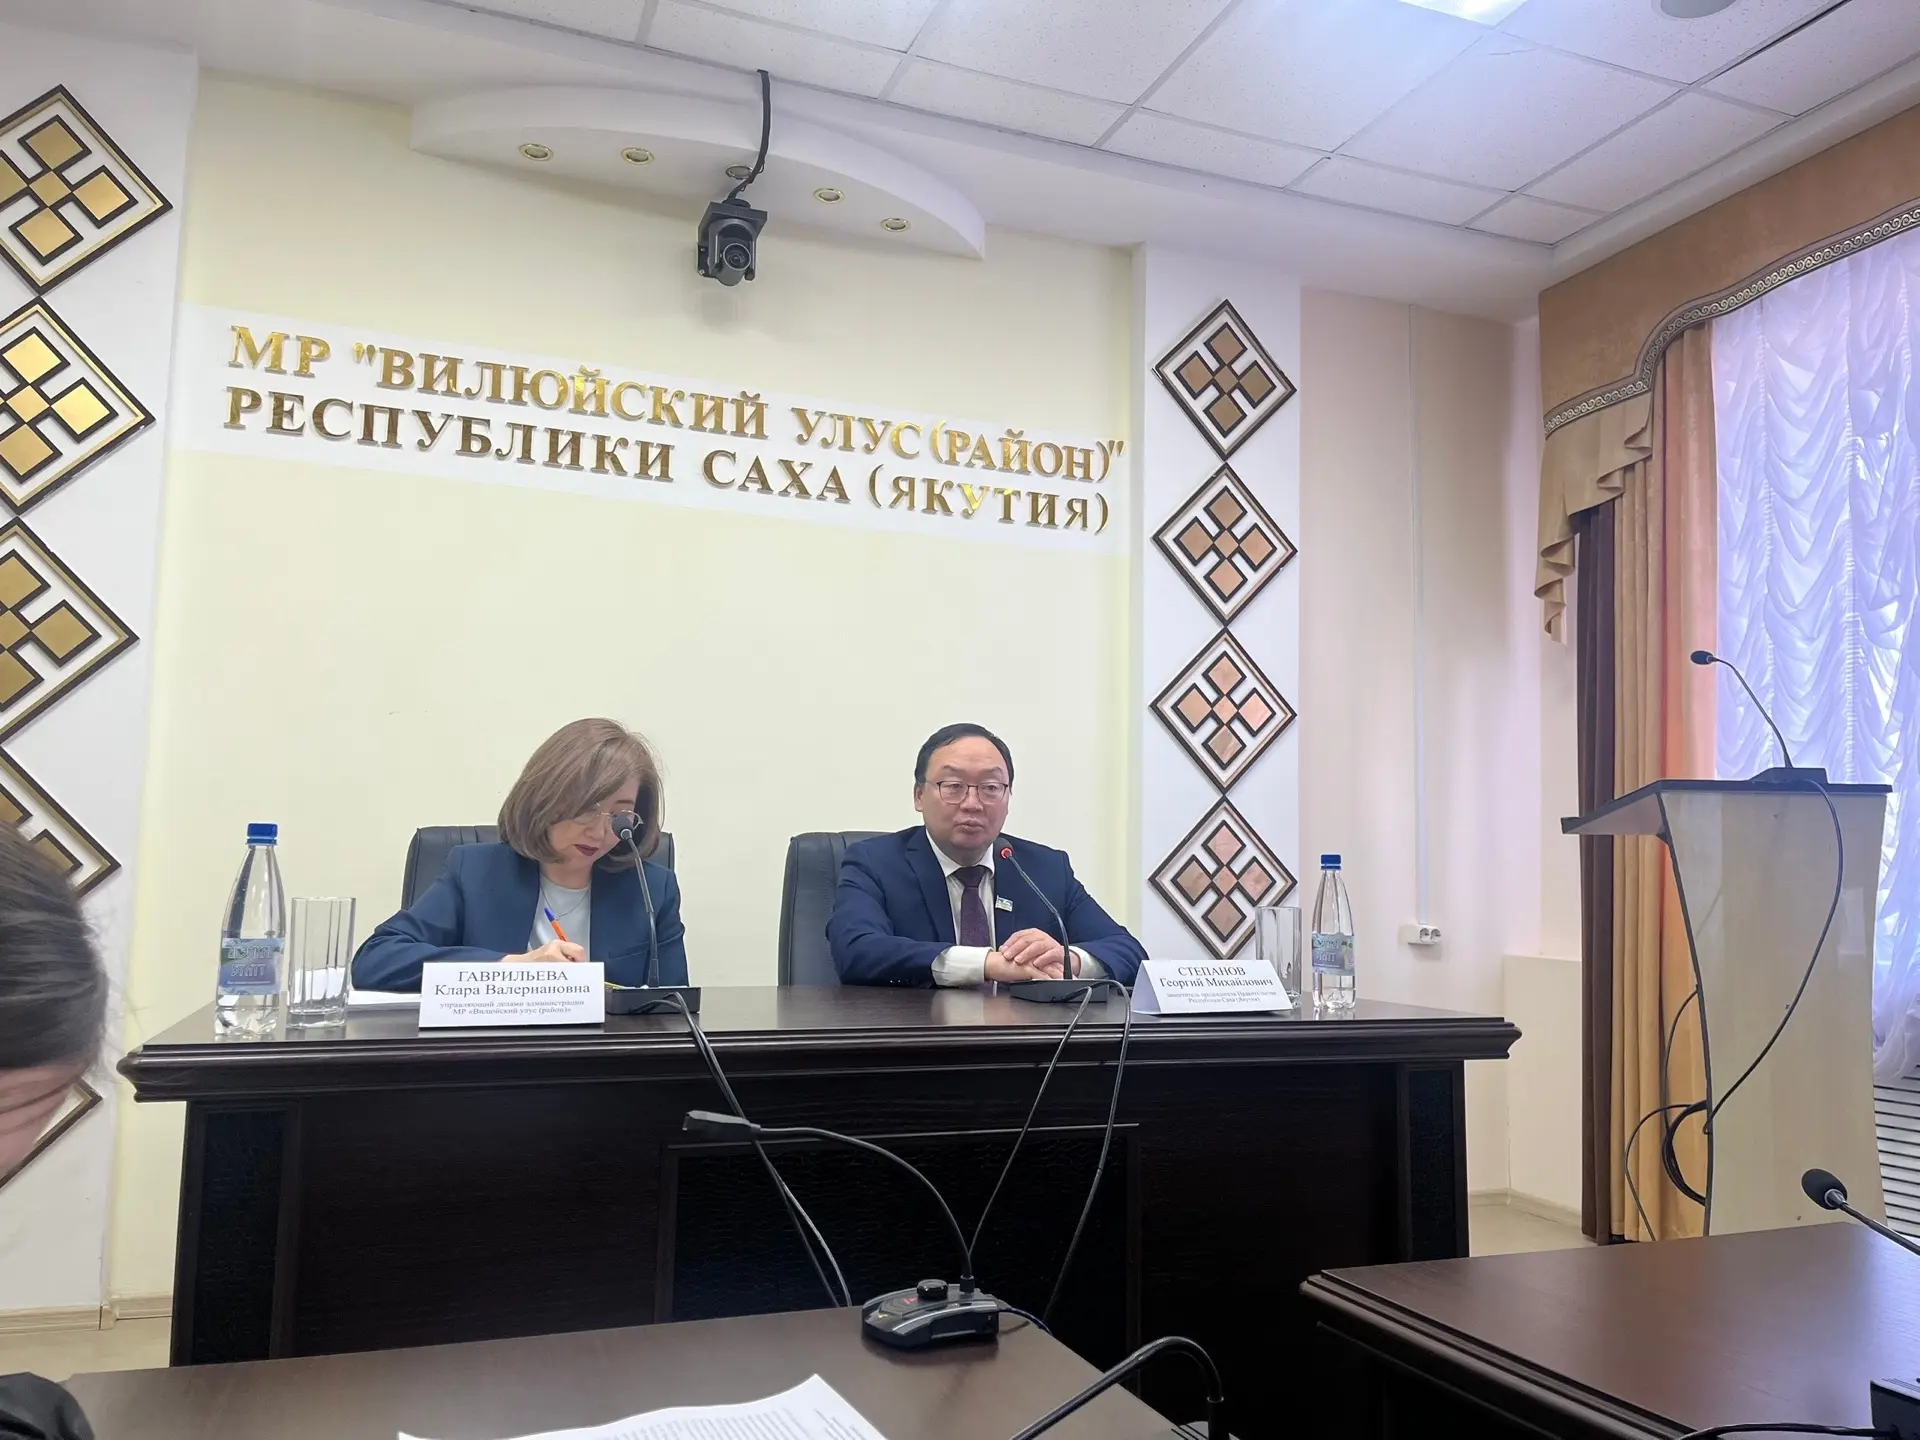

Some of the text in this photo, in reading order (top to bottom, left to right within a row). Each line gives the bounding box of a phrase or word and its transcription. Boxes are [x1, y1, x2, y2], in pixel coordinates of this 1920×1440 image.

[228, 325, 331, 379] МР
[790, 406, 922, 460] УЛУС
[223, 385, 1109, 535] РЕСПУБЛИКИ САХА (ЯКУТИЯ)
[457, 970, 569, 982] ГАВРИЛЬЕВА
[1177, 966, 1246, 977] СТЕПАНОВ
[434, 983, 591, 998] Клара Валериановна
[1159, 977, 1274, 990] Георгий Михайлович
